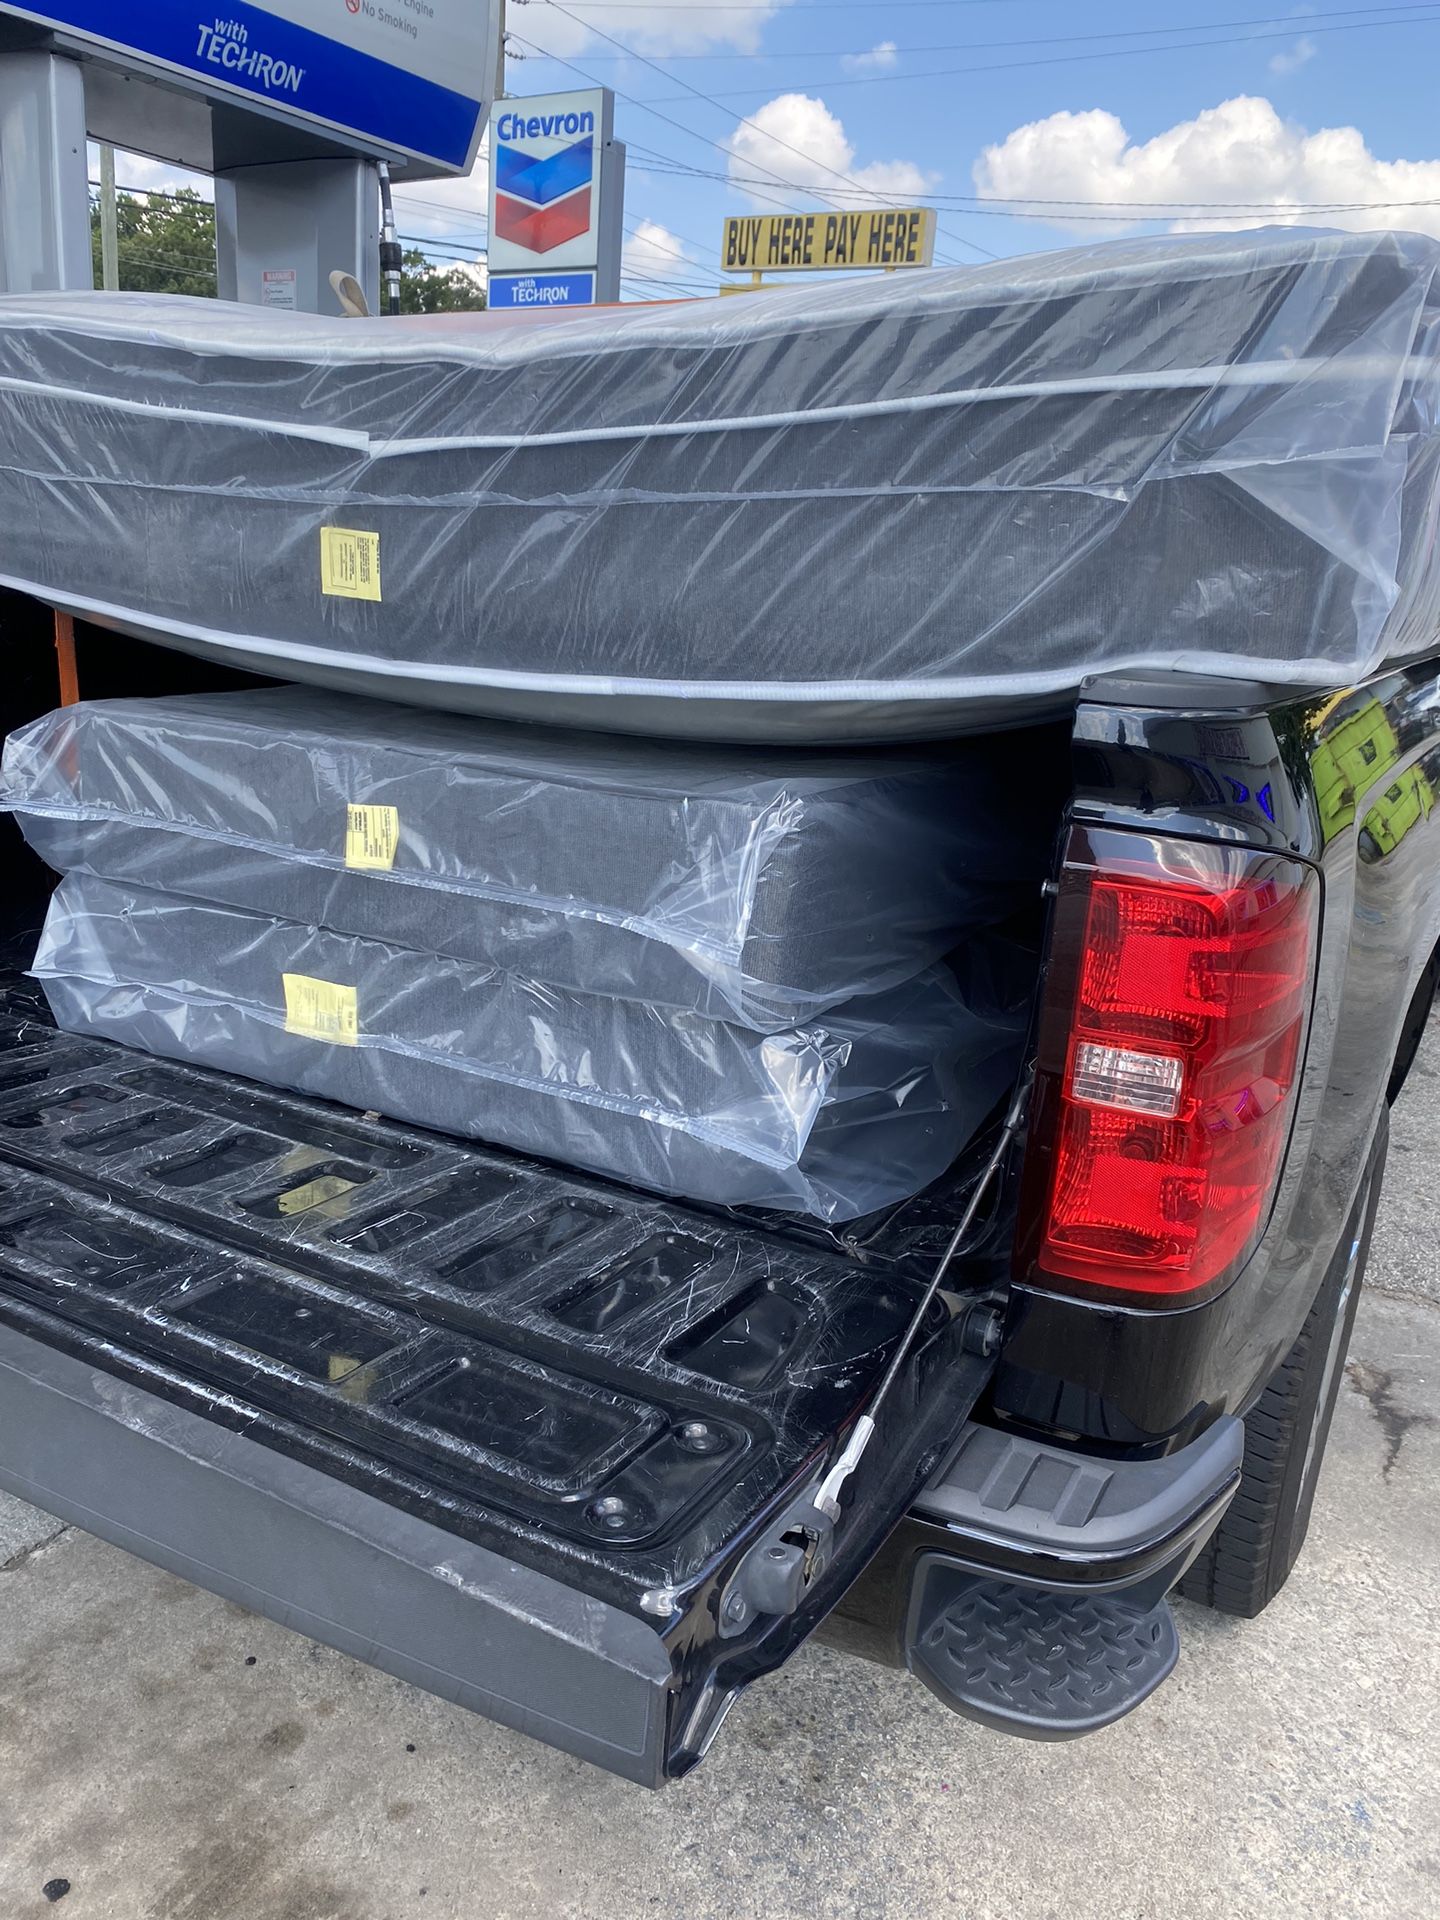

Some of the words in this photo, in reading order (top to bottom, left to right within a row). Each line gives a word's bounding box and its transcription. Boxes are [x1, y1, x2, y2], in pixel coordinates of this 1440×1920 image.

[362, 0, 375, 17] No
[378, 8, 418, 39] Smoking
[404, 0, 434, 18] Engine
[214, 18, 248, 44] with
[196, 24, 303, 92] TECHRON
[497, 110, 594, 141] Chevron
[727, 219, 762, 266] BUY
[768, 217, 815, 265] HERE
[824, 215, 862, 264] PAY
[868, 213, 920, 262] HERE
[511, 286, 569, 304] TECHRON
[518, 278, 536, 288] with
